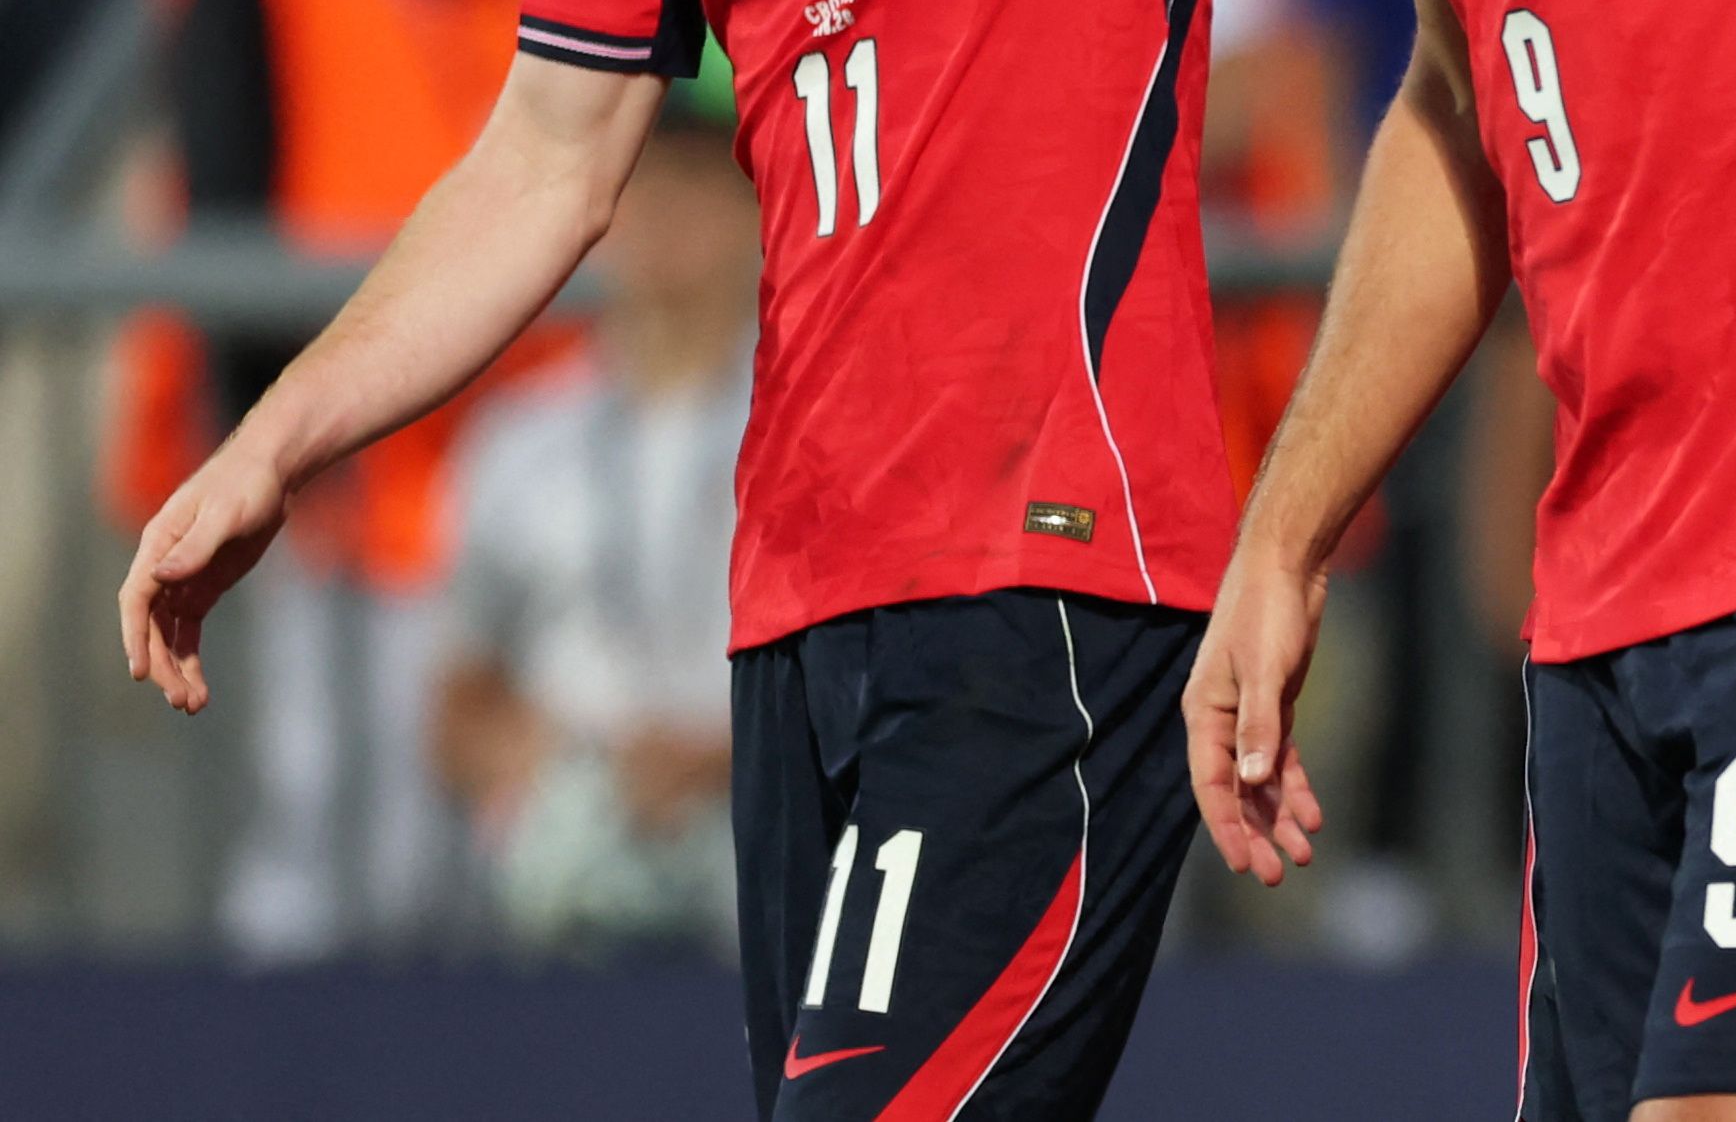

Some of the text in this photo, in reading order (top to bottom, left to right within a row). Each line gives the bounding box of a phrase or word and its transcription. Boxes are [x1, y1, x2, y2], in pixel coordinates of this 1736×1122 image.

[792, 37, 881, 238] 11
[1501, 8, 1581, 204] 9
[801, 824, 924, 1014] 11
